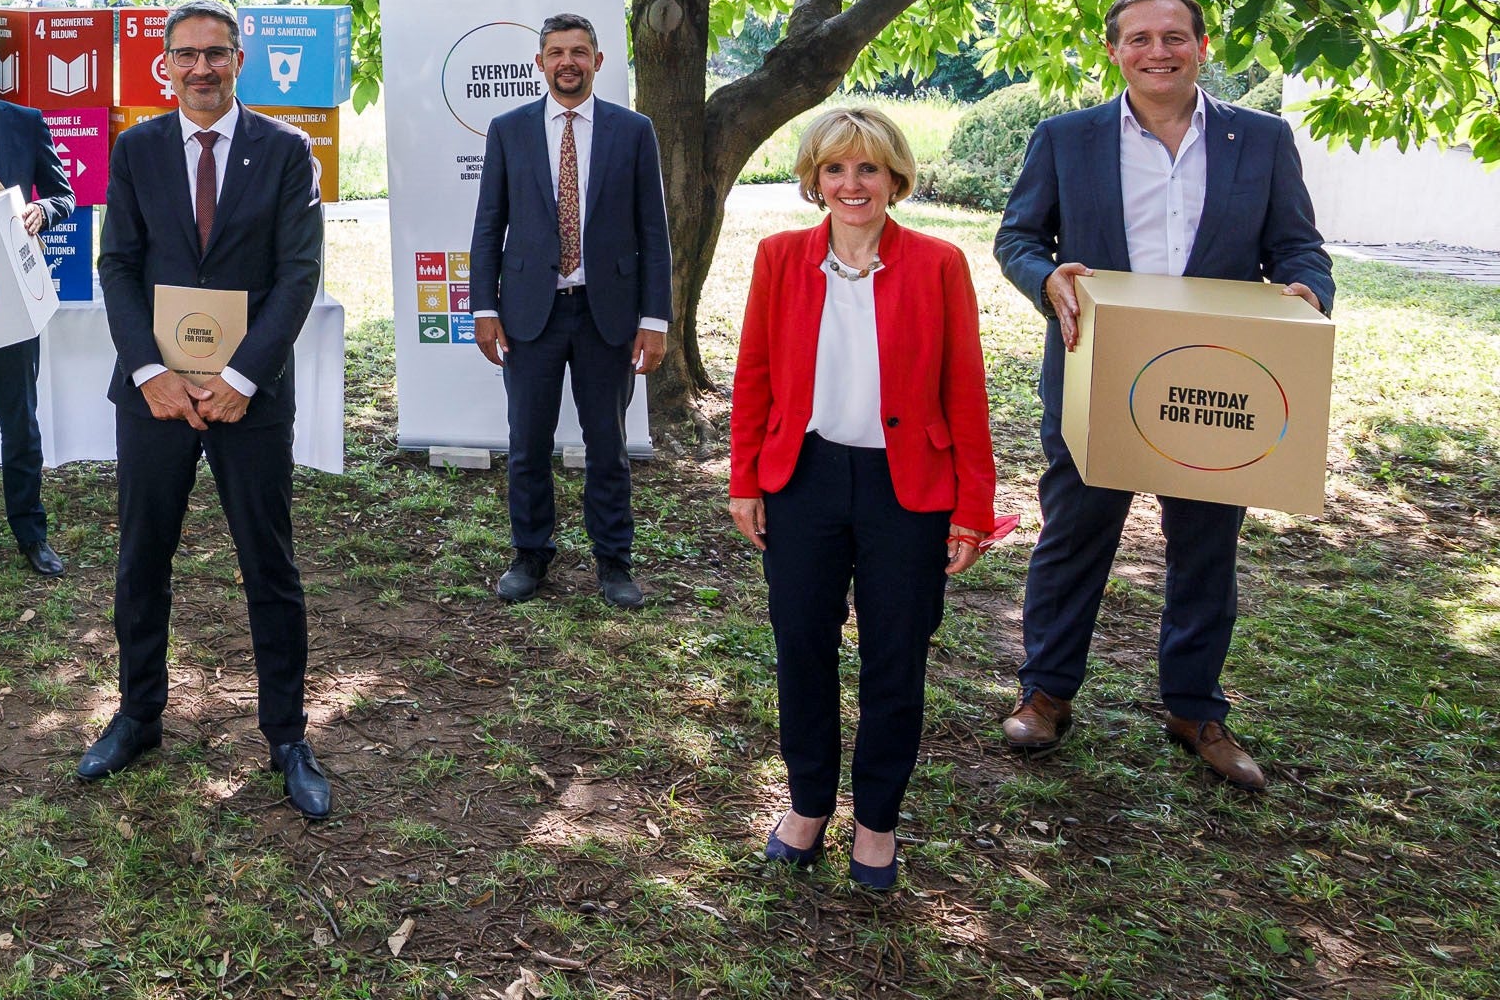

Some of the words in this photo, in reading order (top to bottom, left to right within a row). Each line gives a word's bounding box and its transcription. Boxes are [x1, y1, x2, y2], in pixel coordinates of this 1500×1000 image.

[51, 18, 94, 27] HOCHWERTIGE
[144, 17, 167, 25] GESCH
[261, 16, 283, 24] CLEAN
[285, 16, 307, 25] WATER
[35, 19, 46, 39] 4
[126, 17, 138, 37] 5
[243, 16, 255, 36] 6
[51, 30, 77, 39] BILDUNG
[144, 29, 164, 37] GLEIC
[261, 28, 275, 36] AND
[277, 28, 316, 36] SANITATION
[472, 63, 534, 80] EVERYDAY
[467, 83, 490, 98] FOR
[494, 81, 541, 97] FUTURE
[73, 116, 81, 125] LE
[50, 127, 98, 137] SUGUAGLIANZE
[42, 235, 68, 243] STARKE
[1168, 386, 1249, 410] EVERYDAY
[1160, 404, 1190, 424] FOR
[1194, 409, 1255, 431] FUTURE
